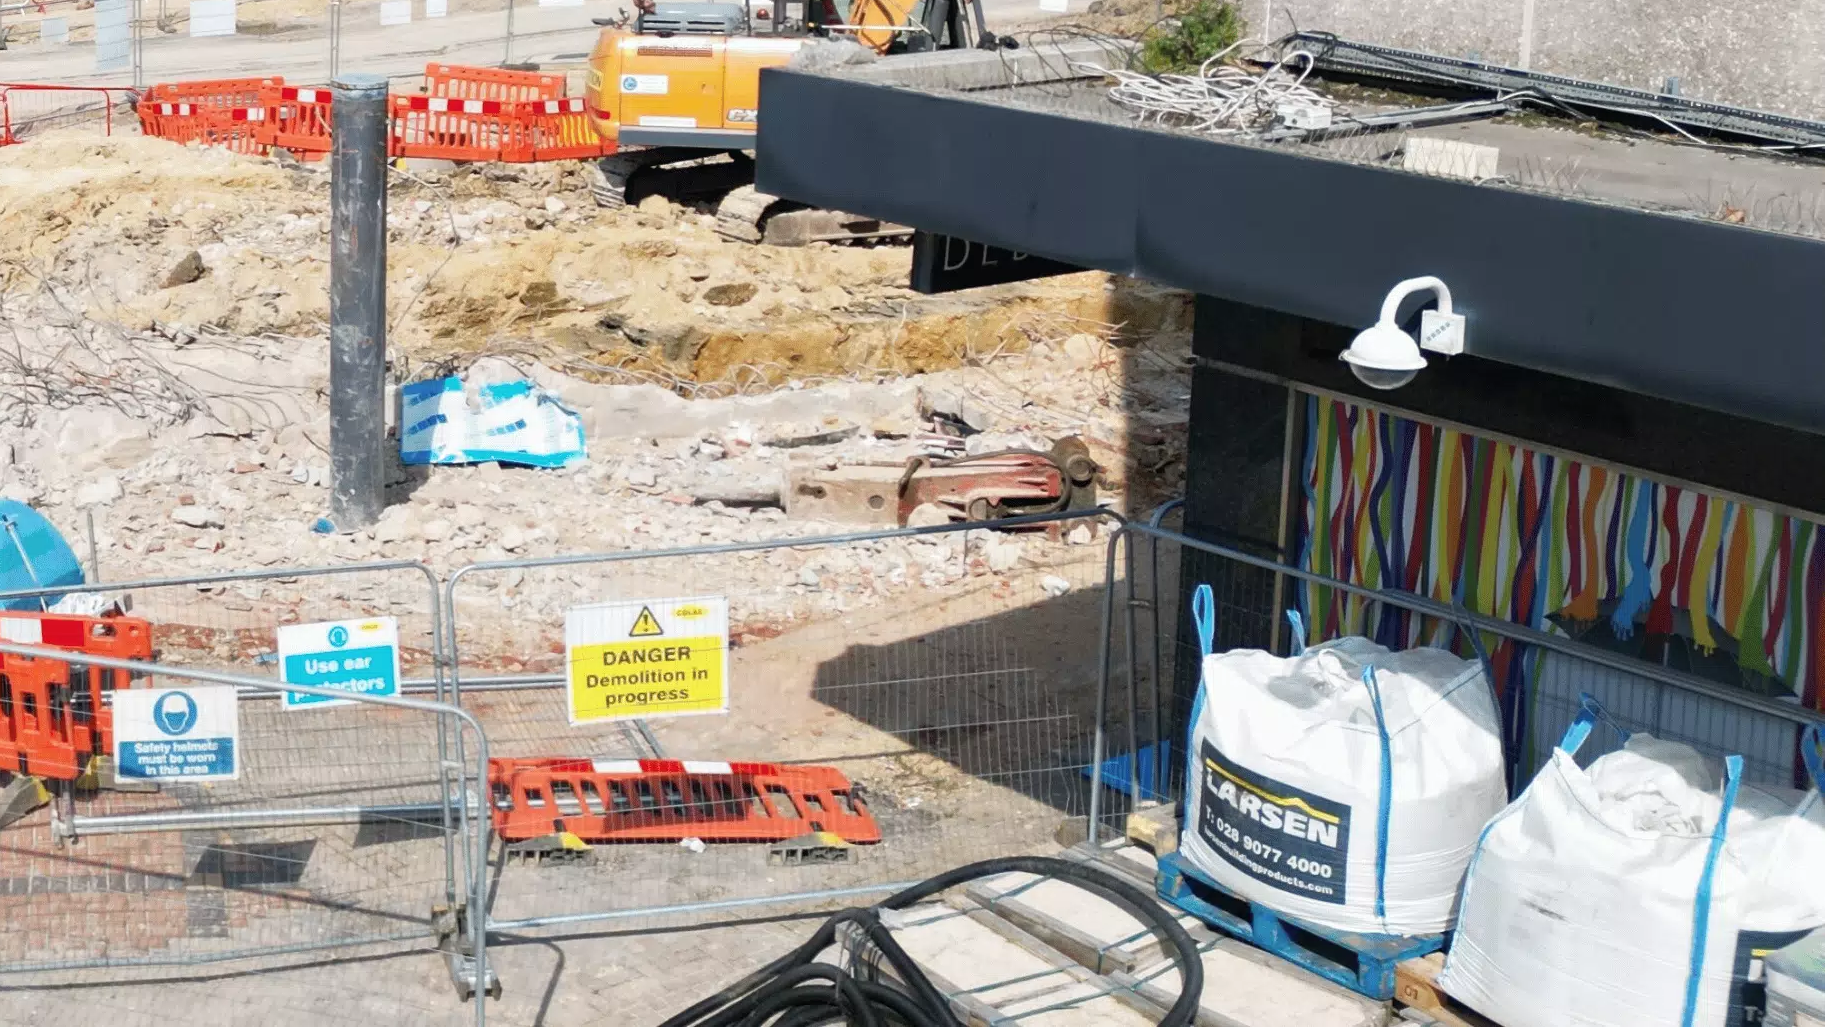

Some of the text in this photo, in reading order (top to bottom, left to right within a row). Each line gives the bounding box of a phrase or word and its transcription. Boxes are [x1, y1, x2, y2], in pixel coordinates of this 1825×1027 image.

[304, 656, 373, 675] Use ear
[602, 645, 691, 667] DANGER
[586, 666, 709, 689] Demolition in
[605, 687, 690, 708] progress
[134, 739, 219, 755] Safety helmets
[138, 752, 217, 765] must be worn
[159, 763, 181, 776] this
[182, 764, 209, 775] area
[1206, 767, 1339, 849] LARSEN
[1216, 817, 1240, 843] 028
[1243, 835, 1283, 863] 9077
[1287, 855, 1333, 879] 4000
